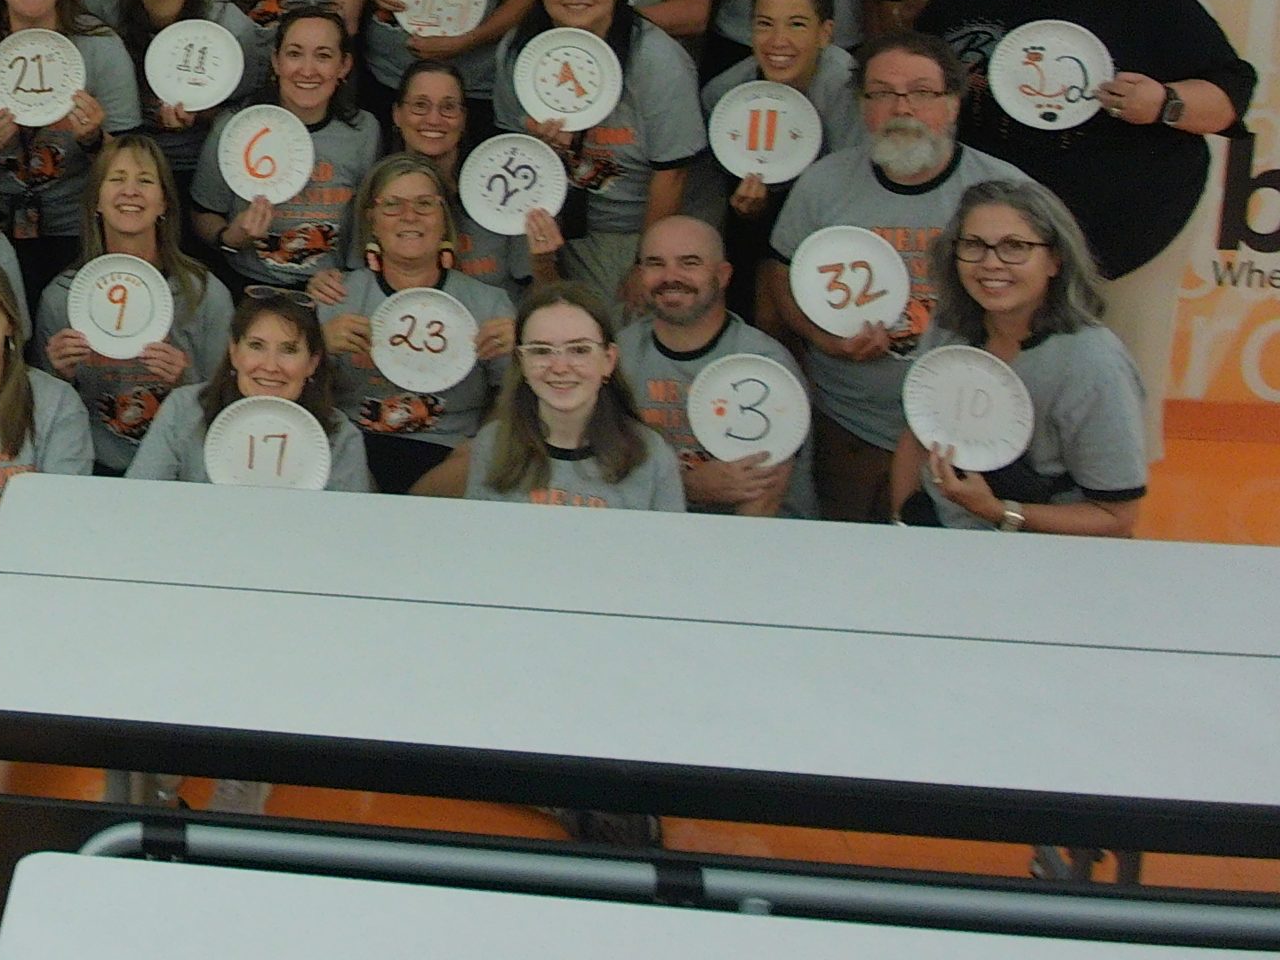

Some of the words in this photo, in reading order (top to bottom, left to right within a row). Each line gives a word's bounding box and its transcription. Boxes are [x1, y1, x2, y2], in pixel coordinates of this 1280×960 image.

[8, 54, 53, 95] 21
[242, 126, 277, 180] 6
[486, 155, 538, 206] 25
[106, 283, 129, 332] 9
[817, 259, 888, 310] 32
[388, 313, 449, 354] 23
[725, 378, 773, 442] 3
[952, 384, 992, 422] 10
[247, 431, 289, 477] 17
